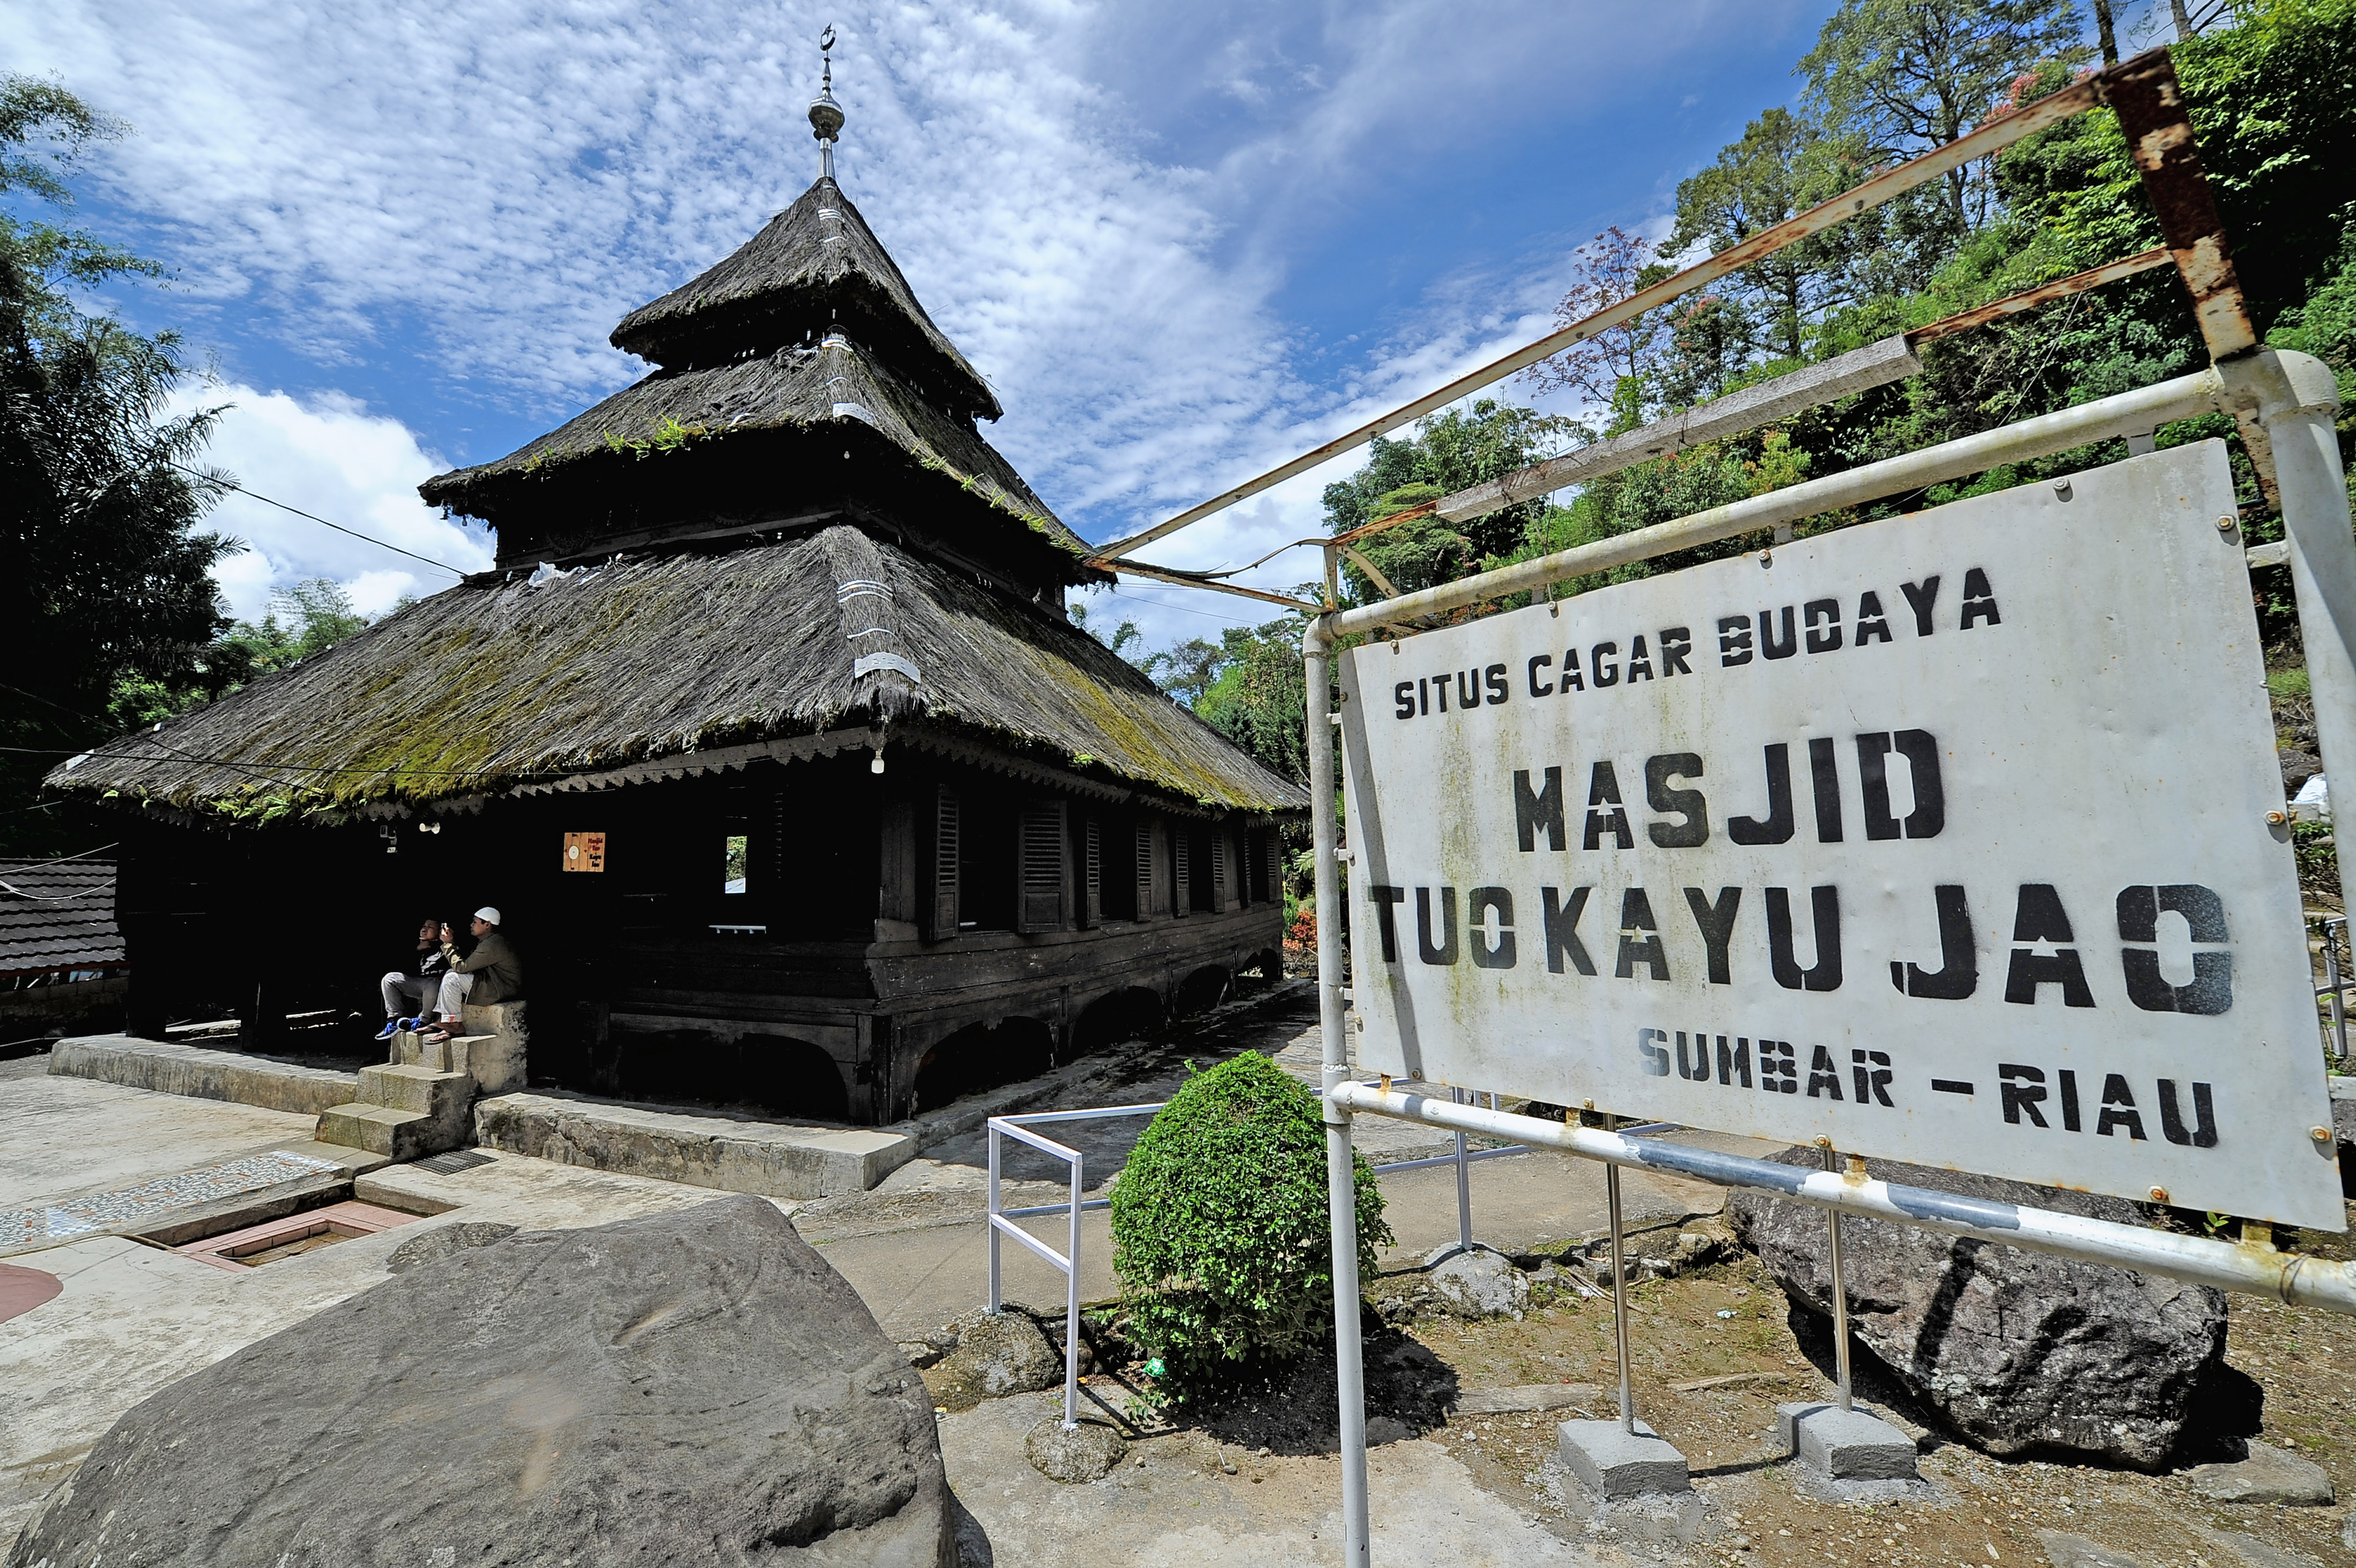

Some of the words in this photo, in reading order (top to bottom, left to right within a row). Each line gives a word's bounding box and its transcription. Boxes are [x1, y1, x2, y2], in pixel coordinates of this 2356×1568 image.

[1394, 662, 1510, 721] SITUS
[1527, 626, 1695, 699] CAGAR
[1719, 566, 2003, 669] BUDAYA
[1513, 727, 1947, 853] MASJID
[1366, 885, 1517, 971] TUO
[1540, 884, 1844, 993] KAYU
[1888, 883, 2236, 1017] JAO
[1635, 1026, 1897, 1109] SUMBAR
[1998, 1062, 2221, 1150] RIAU
